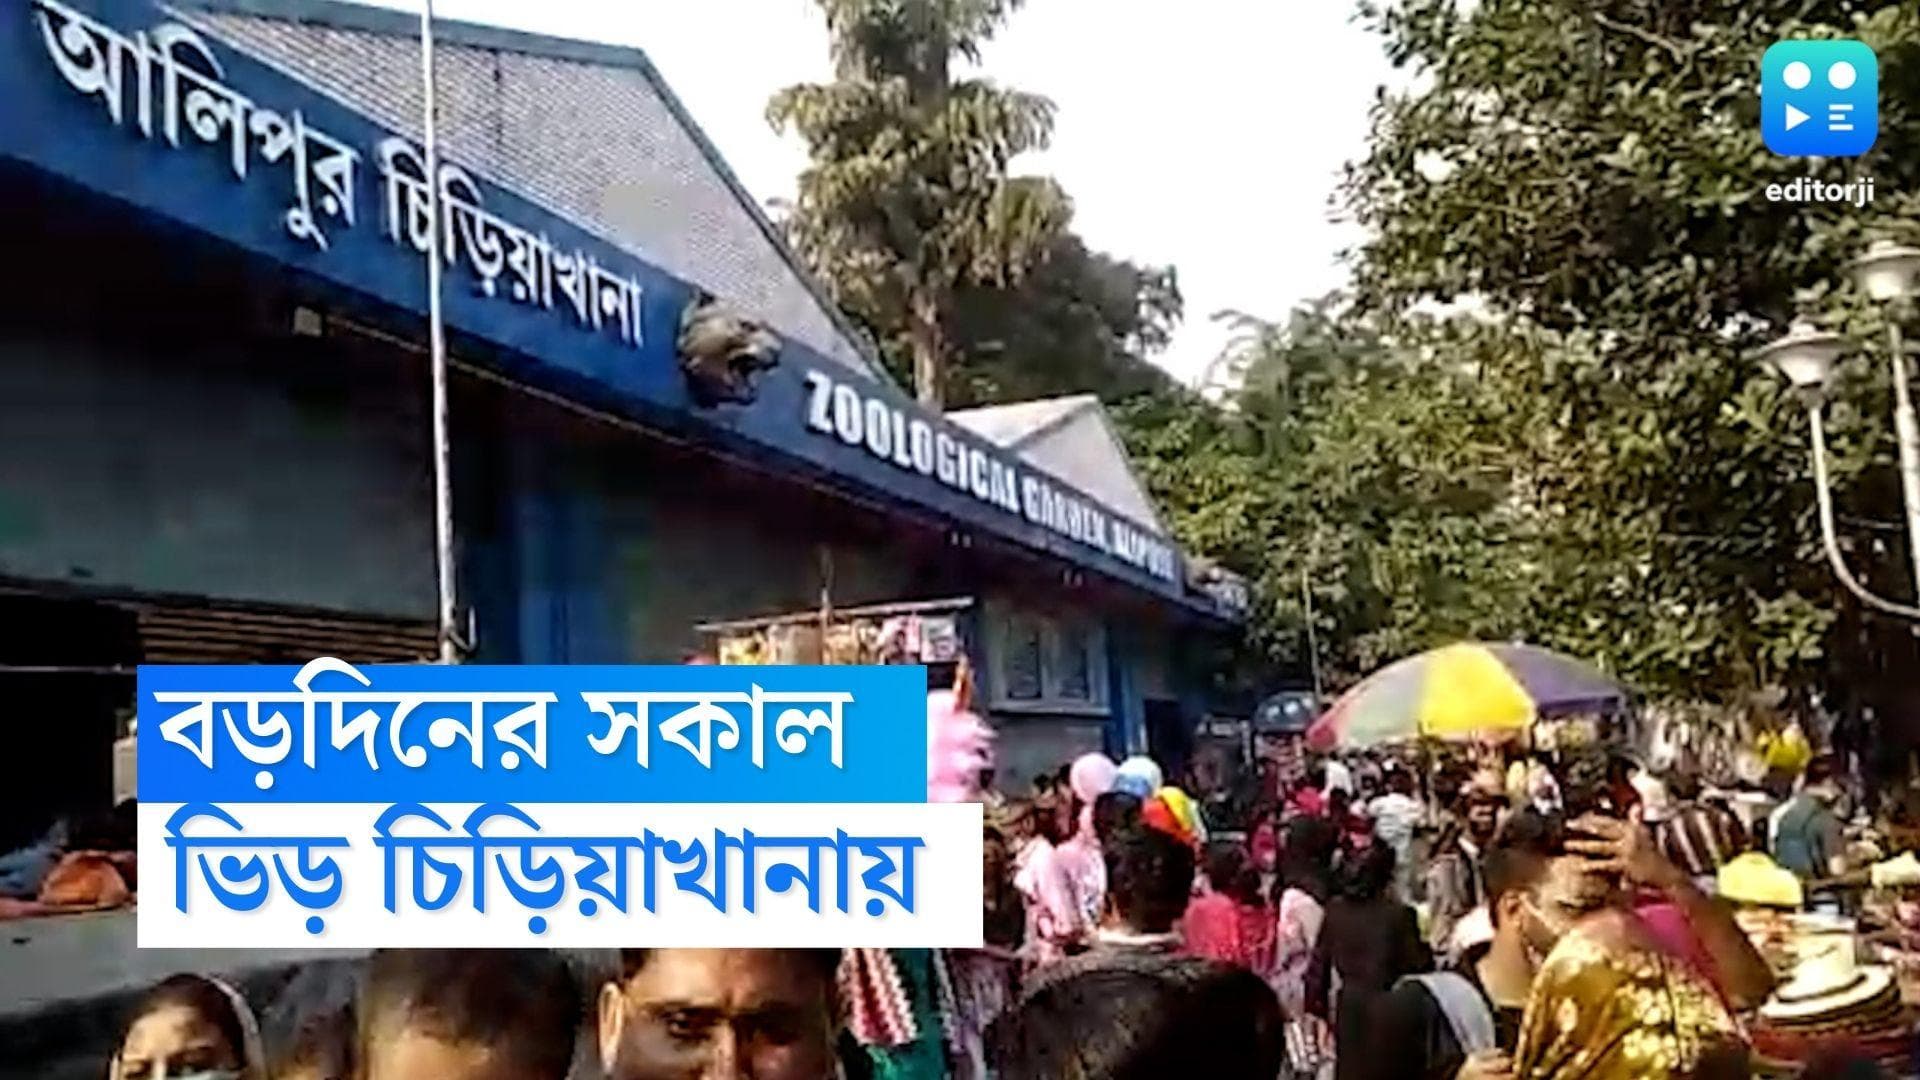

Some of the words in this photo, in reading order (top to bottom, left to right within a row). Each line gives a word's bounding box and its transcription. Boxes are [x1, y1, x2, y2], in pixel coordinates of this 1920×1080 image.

[35, 0, 361, 251] আলিপুর
[379, 136, 644, 347] চিড়িয়াখানা
[804, 371, 1020, 513] ZOOLOGICAL
